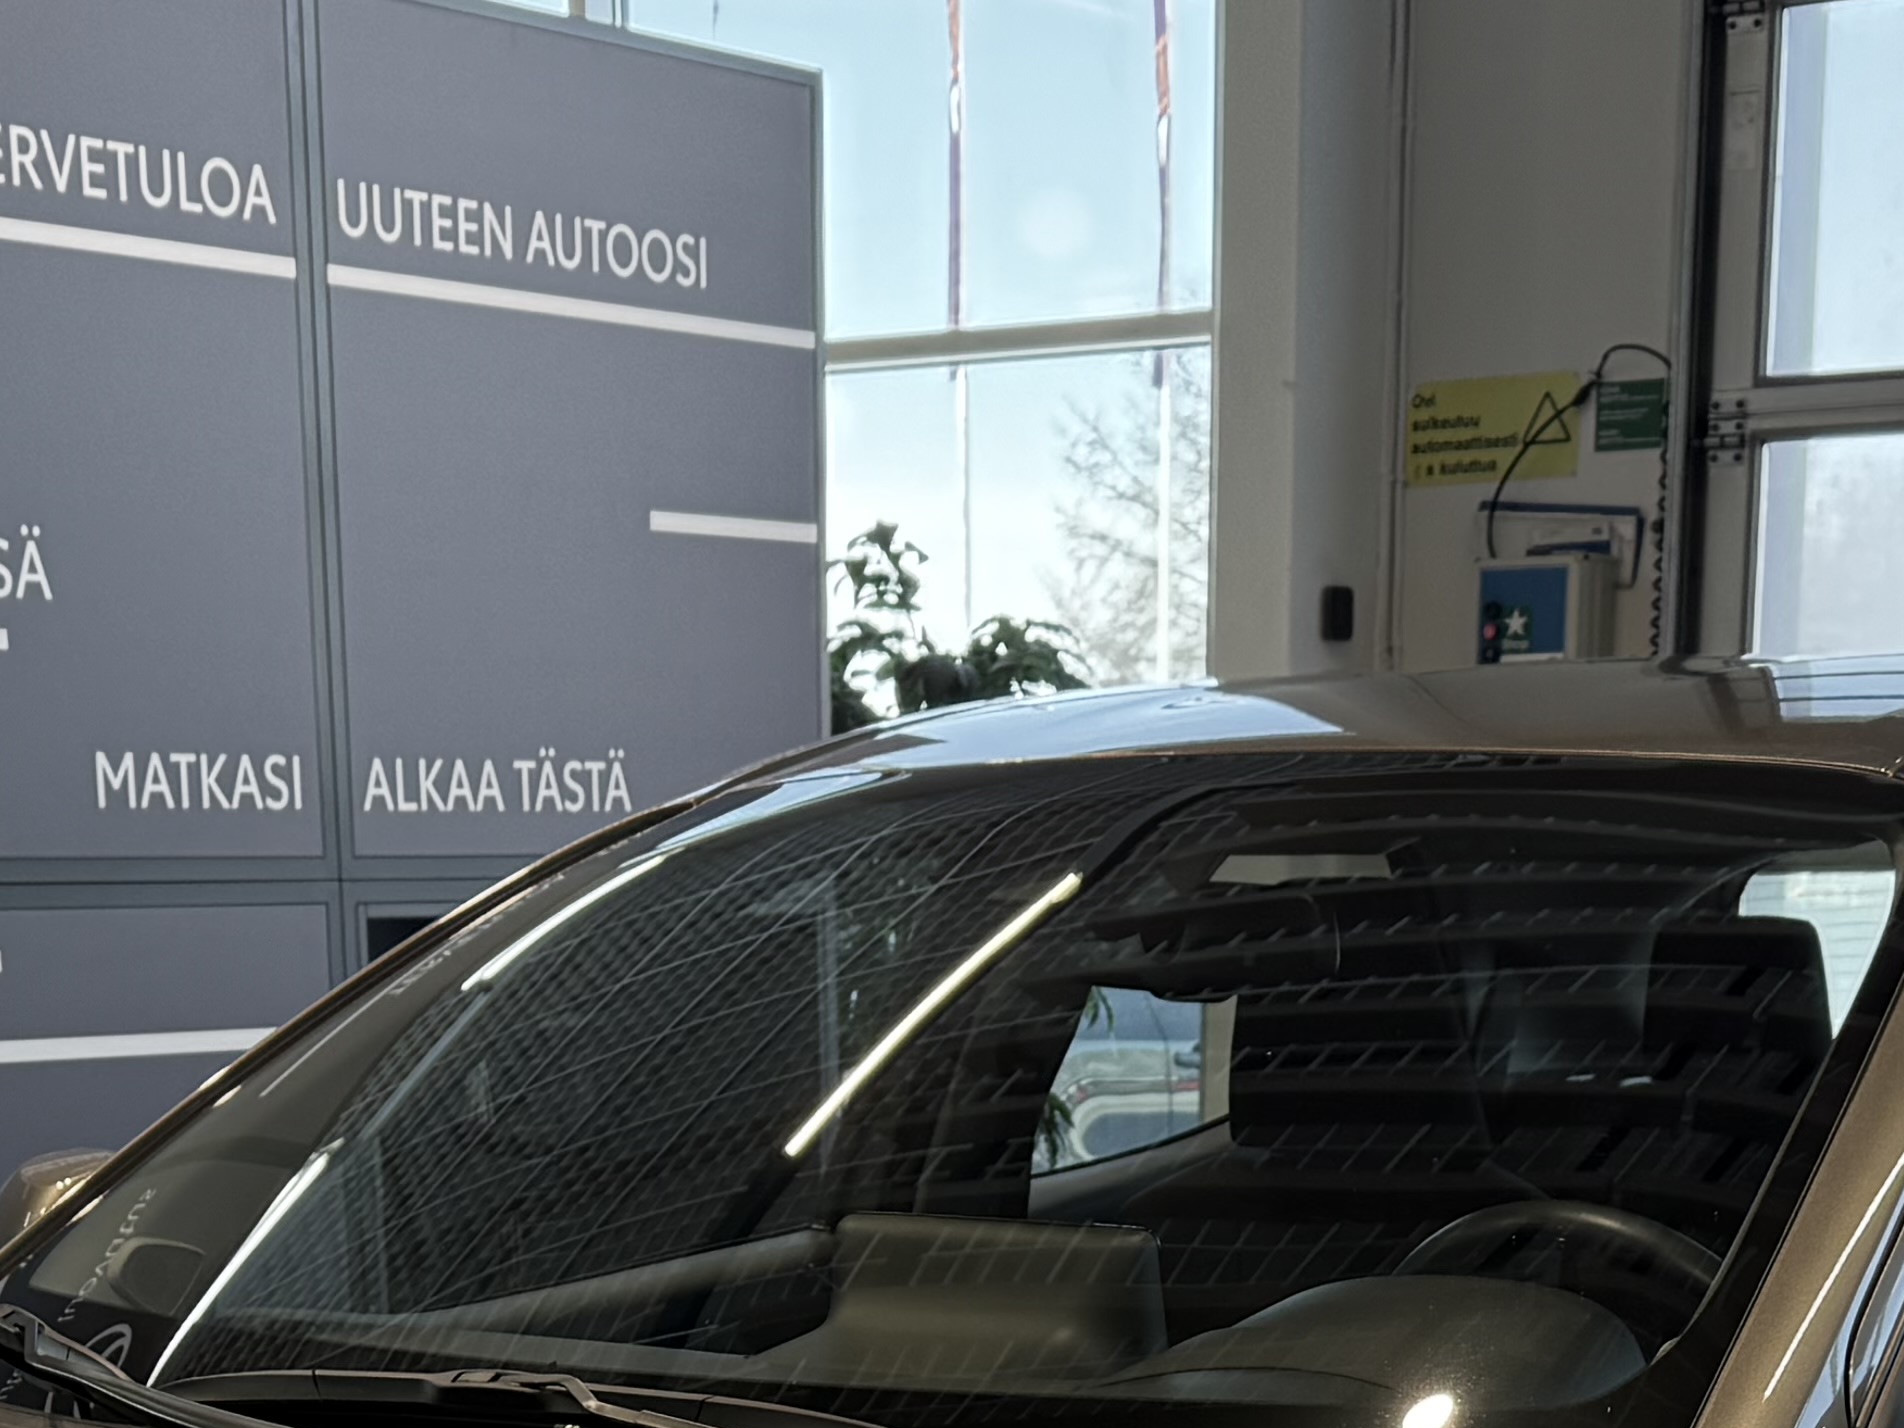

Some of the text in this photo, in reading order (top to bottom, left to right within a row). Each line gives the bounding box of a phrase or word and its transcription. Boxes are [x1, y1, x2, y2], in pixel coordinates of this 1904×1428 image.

[337, 178, 514, 262] UUTEEN
[525, 209, 708, 290] AUTOOSI
[95, 747, 633, 813] MATKASI ALKAA TÄSTÄ
